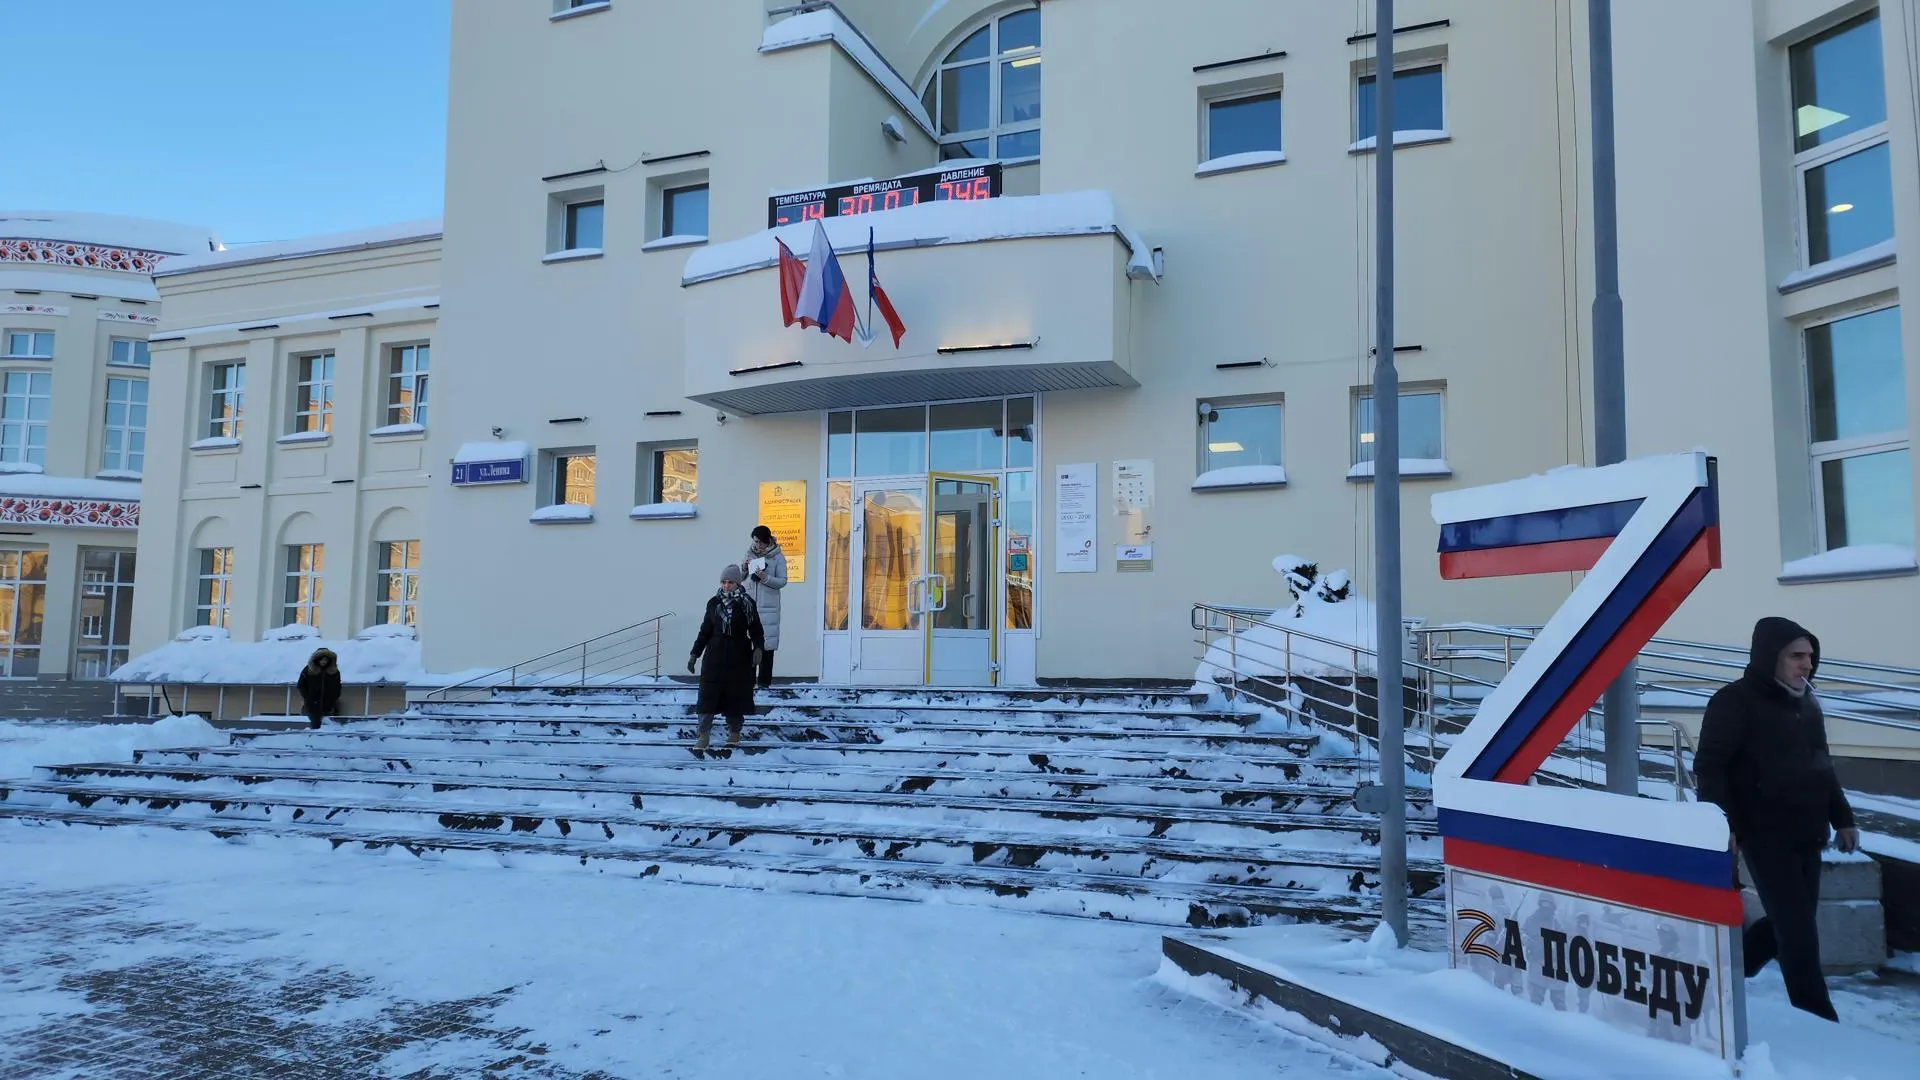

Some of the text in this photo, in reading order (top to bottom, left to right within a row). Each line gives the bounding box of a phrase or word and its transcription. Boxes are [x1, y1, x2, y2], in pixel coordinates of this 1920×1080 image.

[940, 167, 985, 183] ДАВЛЕНИЕ
[853, 179, 902, 195] ВРЕМЯ/ДАТА
[939, 177, 990, 201] 746
[775, 191, 827, 206] ТЕМПЕРАТУРА
[455, 468, 463, 480] 21
[1540, 927, 1710, 1026] ПОБЕДУ
